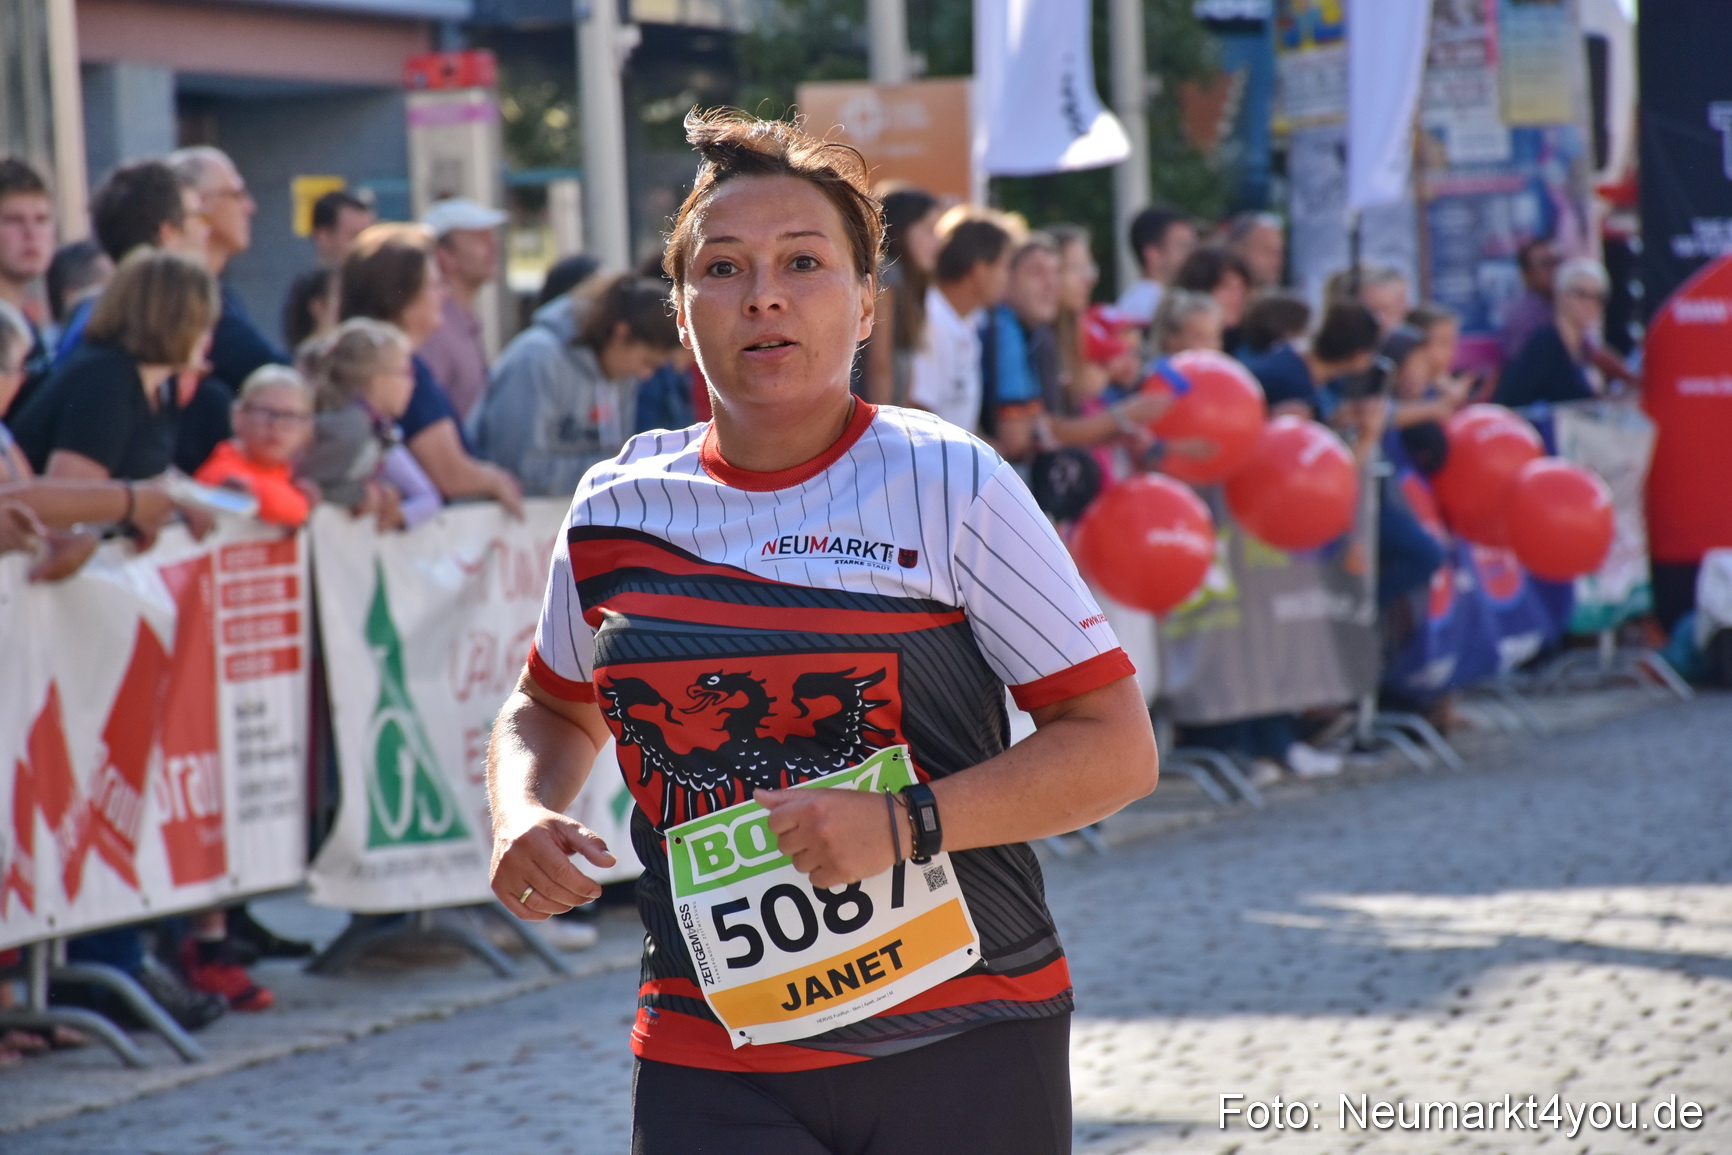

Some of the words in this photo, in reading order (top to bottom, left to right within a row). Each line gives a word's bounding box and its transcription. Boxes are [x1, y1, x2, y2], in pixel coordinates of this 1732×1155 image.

[761, 535, 895, 563] NEUMARKT
[866, 562, 891, 571] STADT
[781, 938, 904, 1012] JANET
